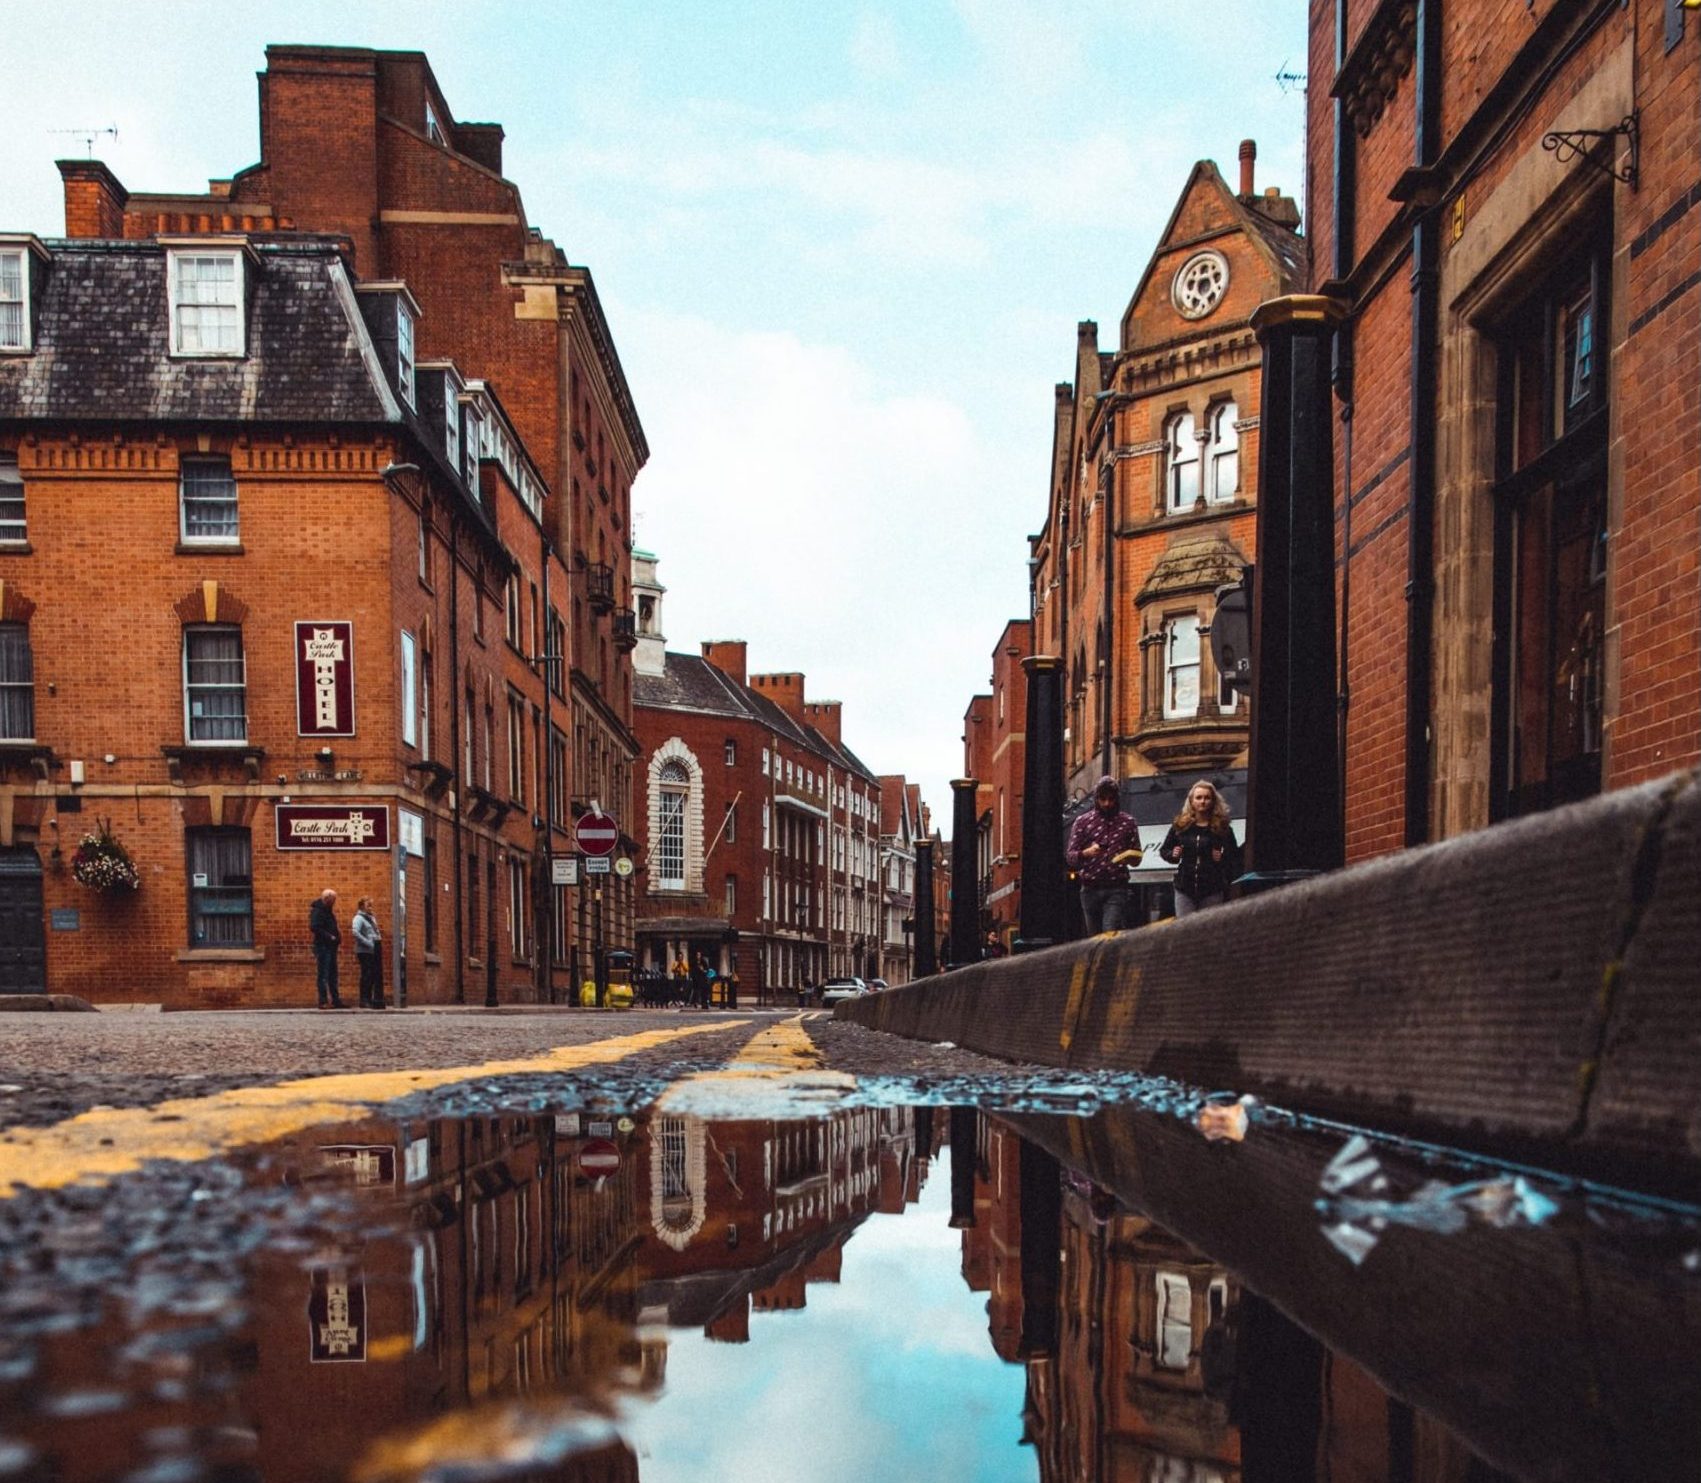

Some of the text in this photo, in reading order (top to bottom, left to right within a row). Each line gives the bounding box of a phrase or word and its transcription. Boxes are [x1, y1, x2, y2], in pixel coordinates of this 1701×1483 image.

[309, 642, 339, 650] Castle
[309, 650, 335, 658] Park
[316, 666, 334, 720] HOTEL
[294, 821, 348, 833] Castle Park
